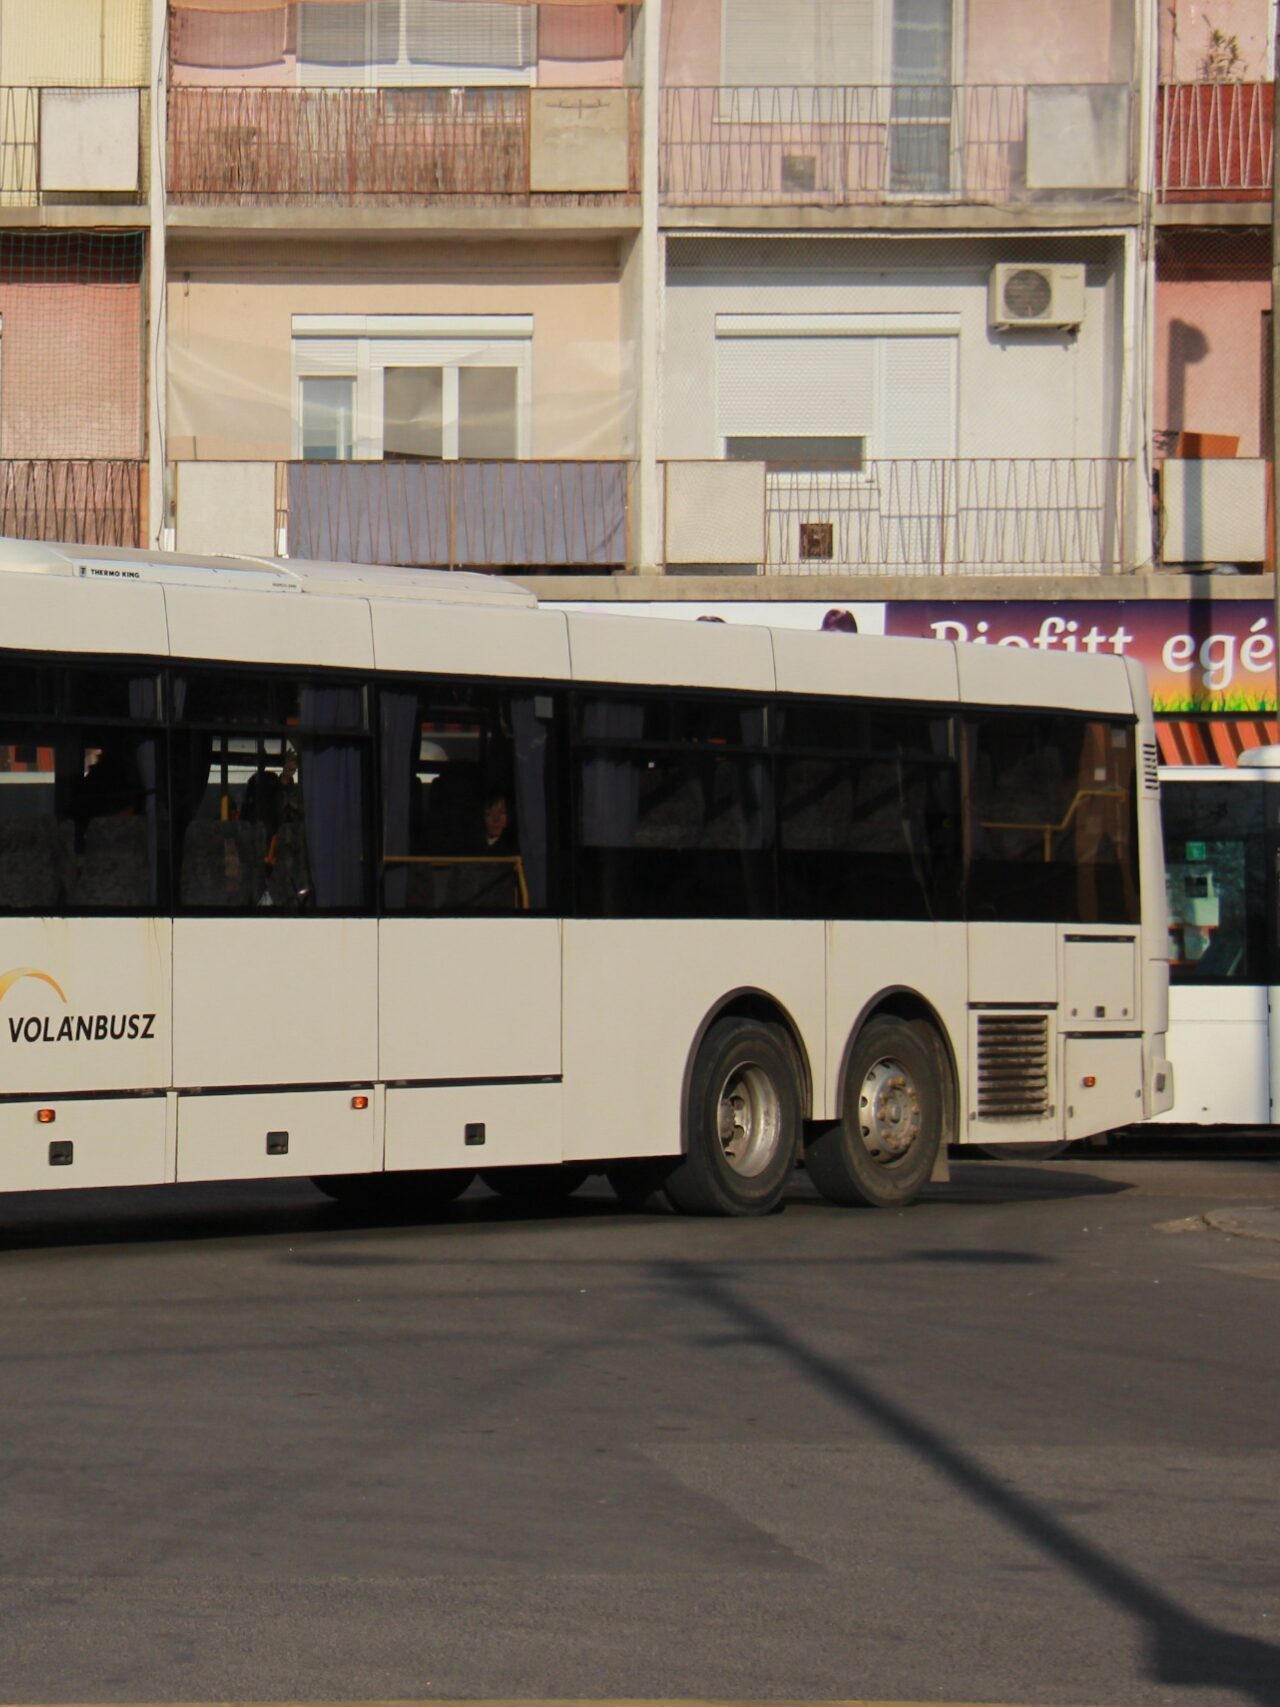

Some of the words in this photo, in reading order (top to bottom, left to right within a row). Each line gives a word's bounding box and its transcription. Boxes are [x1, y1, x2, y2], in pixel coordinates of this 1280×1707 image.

[91, 569, 120, 577] THERMO
[121, 571, 140, 579] KING
[8, 1013, 157, 1043] VOLÁNBUSZ
